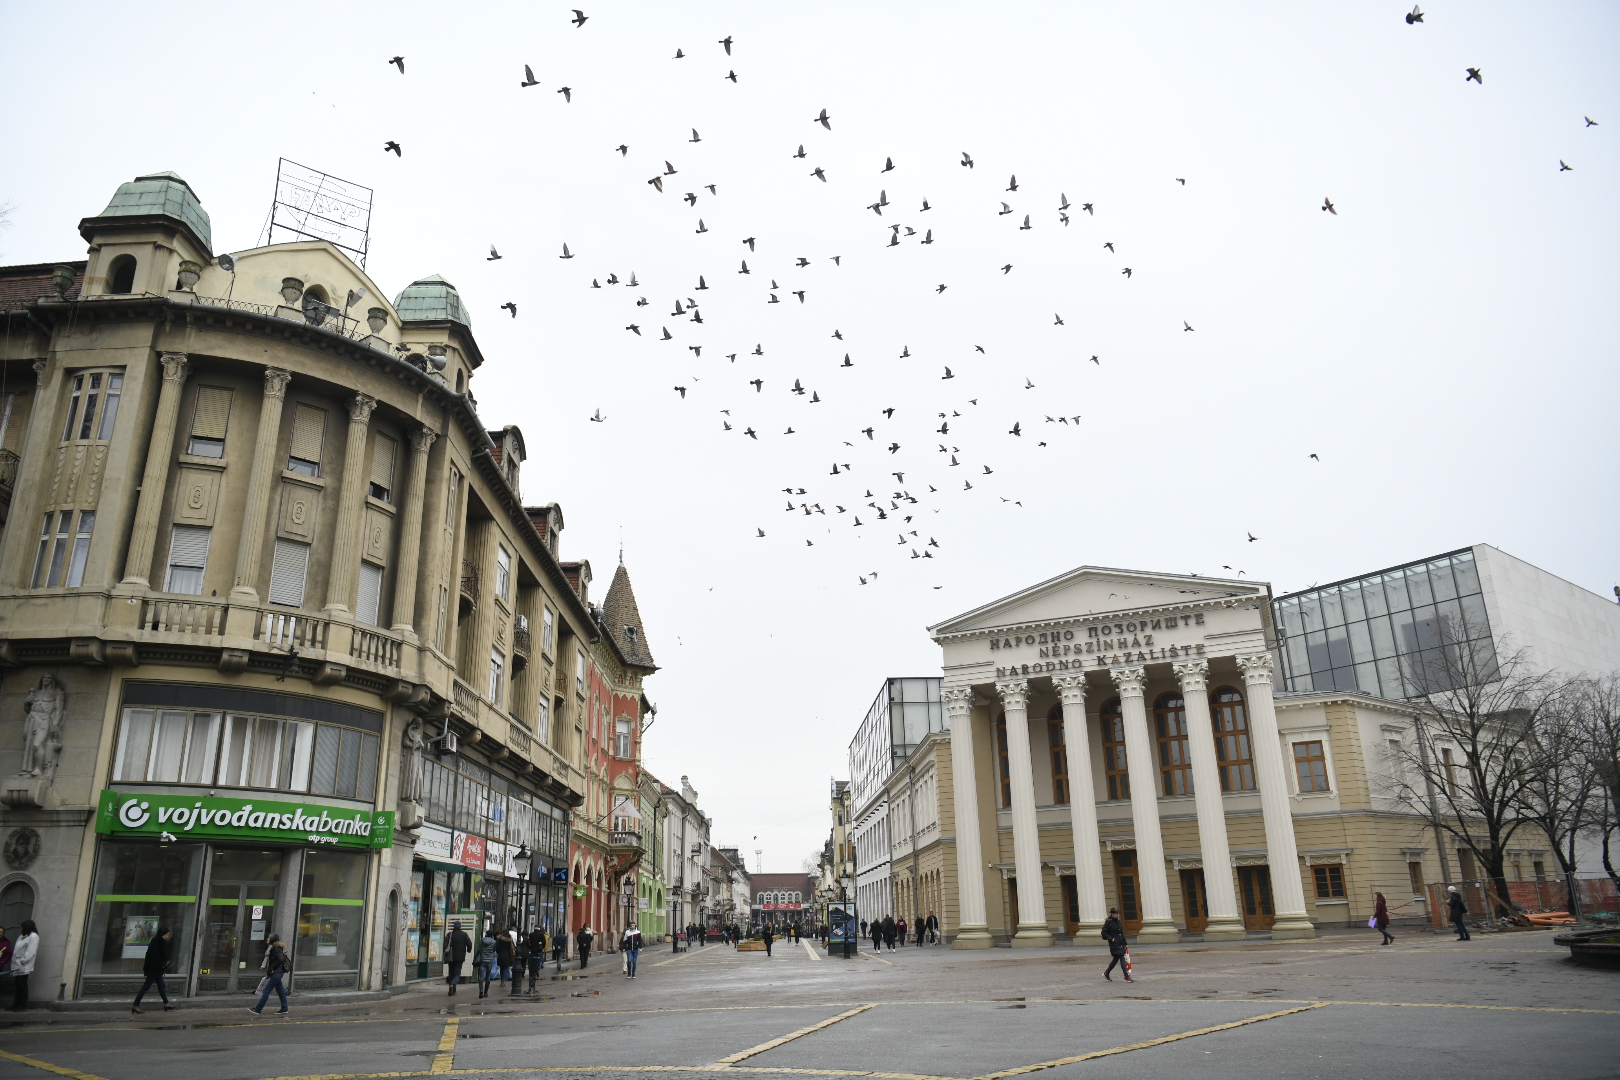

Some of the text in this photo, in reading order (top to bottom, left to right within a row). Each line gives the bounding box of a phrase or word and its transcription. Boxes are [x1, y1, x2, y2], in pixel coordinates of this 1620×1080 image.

[989, 613, 1205, 650] НАРОДНО ПОЗОРИШТЕ
[1039, 633, 1154, 658] NÉPSZÍNHÁZ
[996, 643, 1205, 677] NARODNO KAZALIŠTE
[308, 834, 339, 845] otp group
